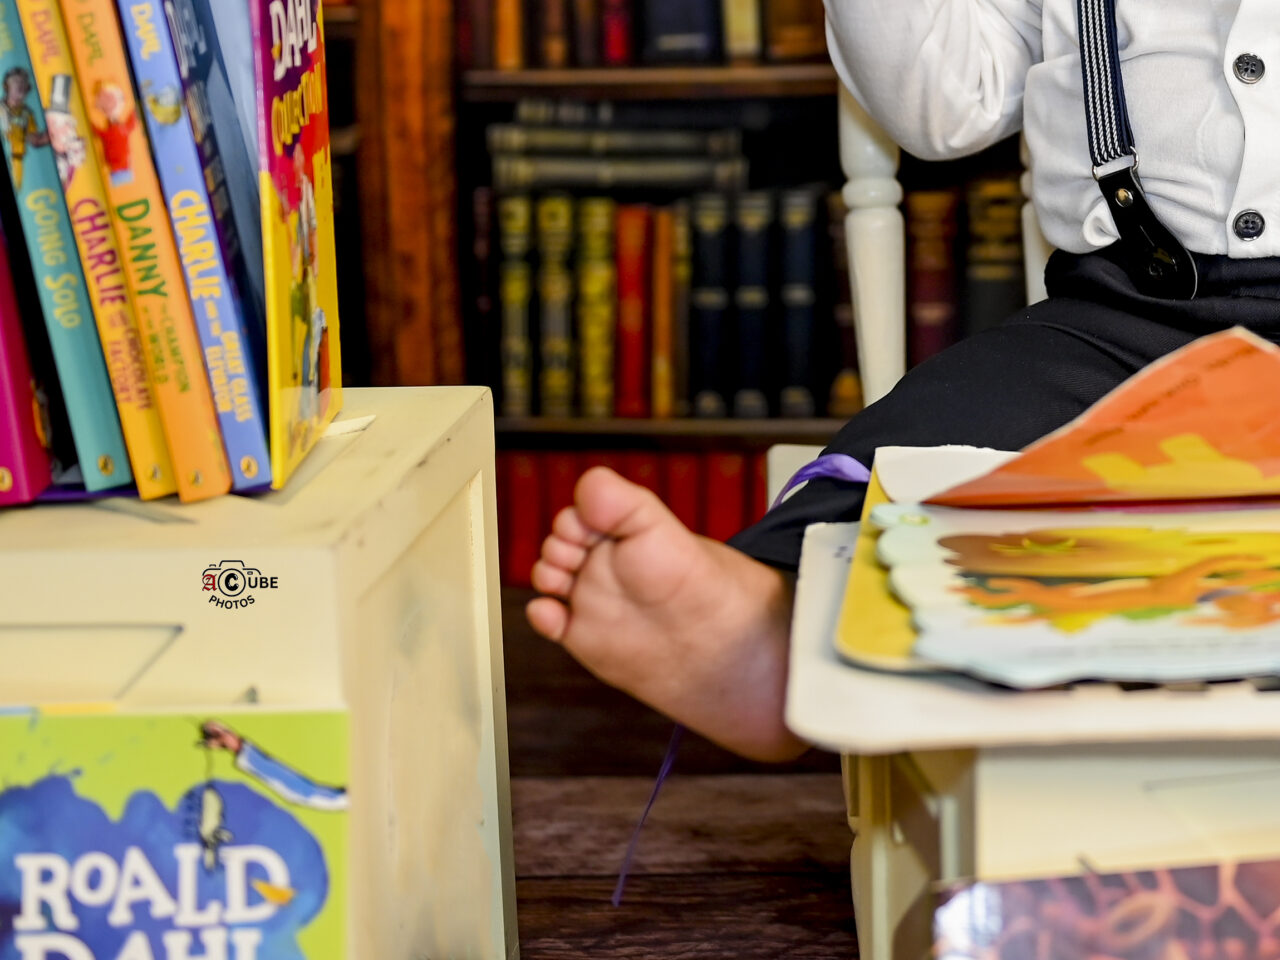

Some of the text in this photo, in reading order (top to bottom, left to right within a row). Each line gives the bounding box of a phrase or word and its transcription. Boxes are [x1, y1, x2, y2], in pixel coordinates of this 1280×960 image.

[26, 188, 81, 329] GOING SOLO
[73, 198, 127, 306] CHARLIE
[115, 198, 168, 297] DANNY
[170, 189, 222, 301] CHARLIE
[12, 842, 291, 931] ROALD
